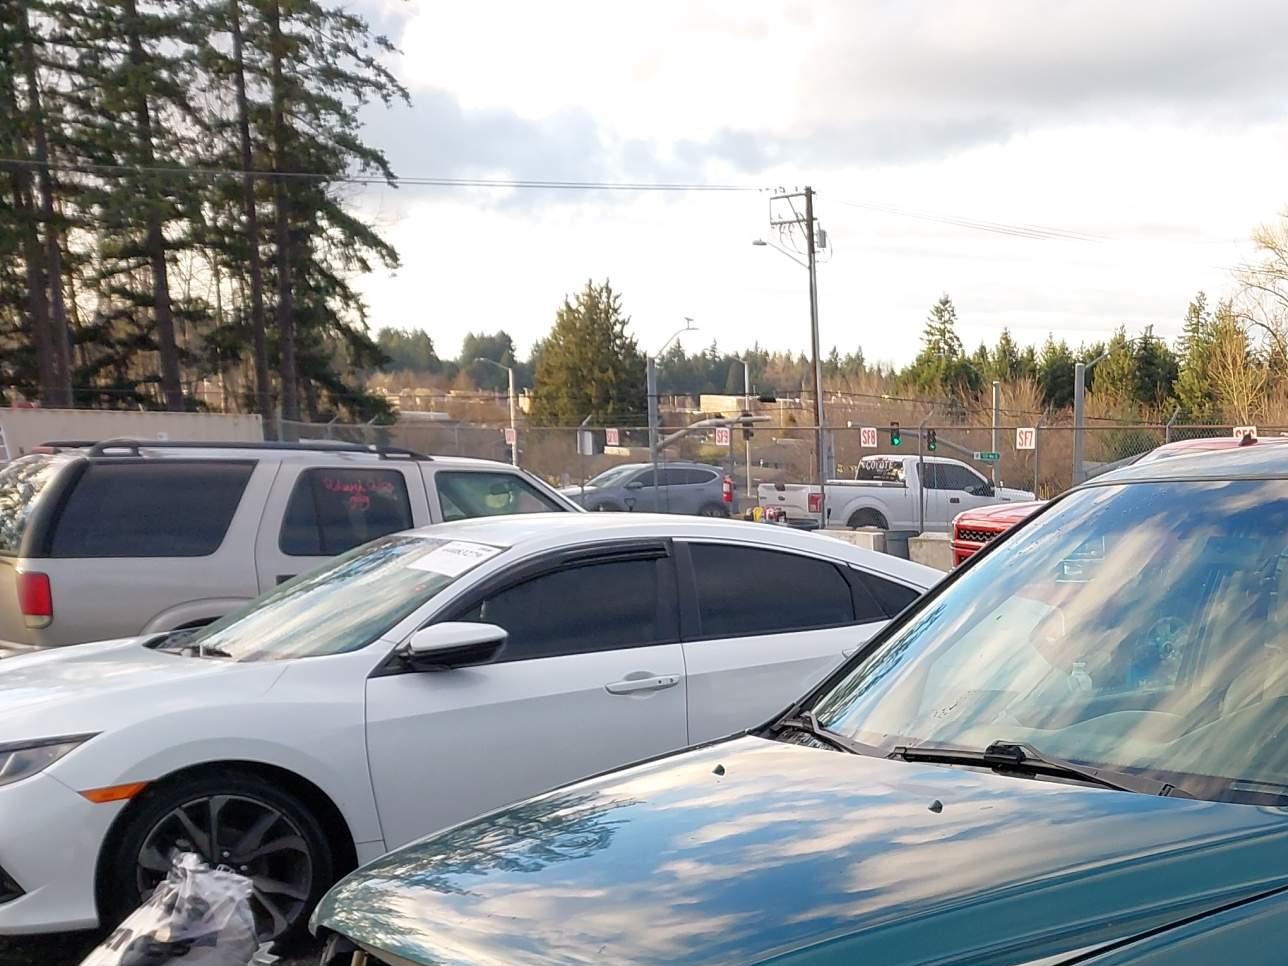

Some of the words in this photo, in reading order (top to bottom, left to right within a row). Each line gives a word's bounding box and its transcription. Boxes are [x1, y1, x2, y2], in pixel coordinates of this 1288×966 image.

[716, 429, 729, 444] SF9
[862, 430, 876, 445] SF8
[1018, 430, 1034, 447] SF7
